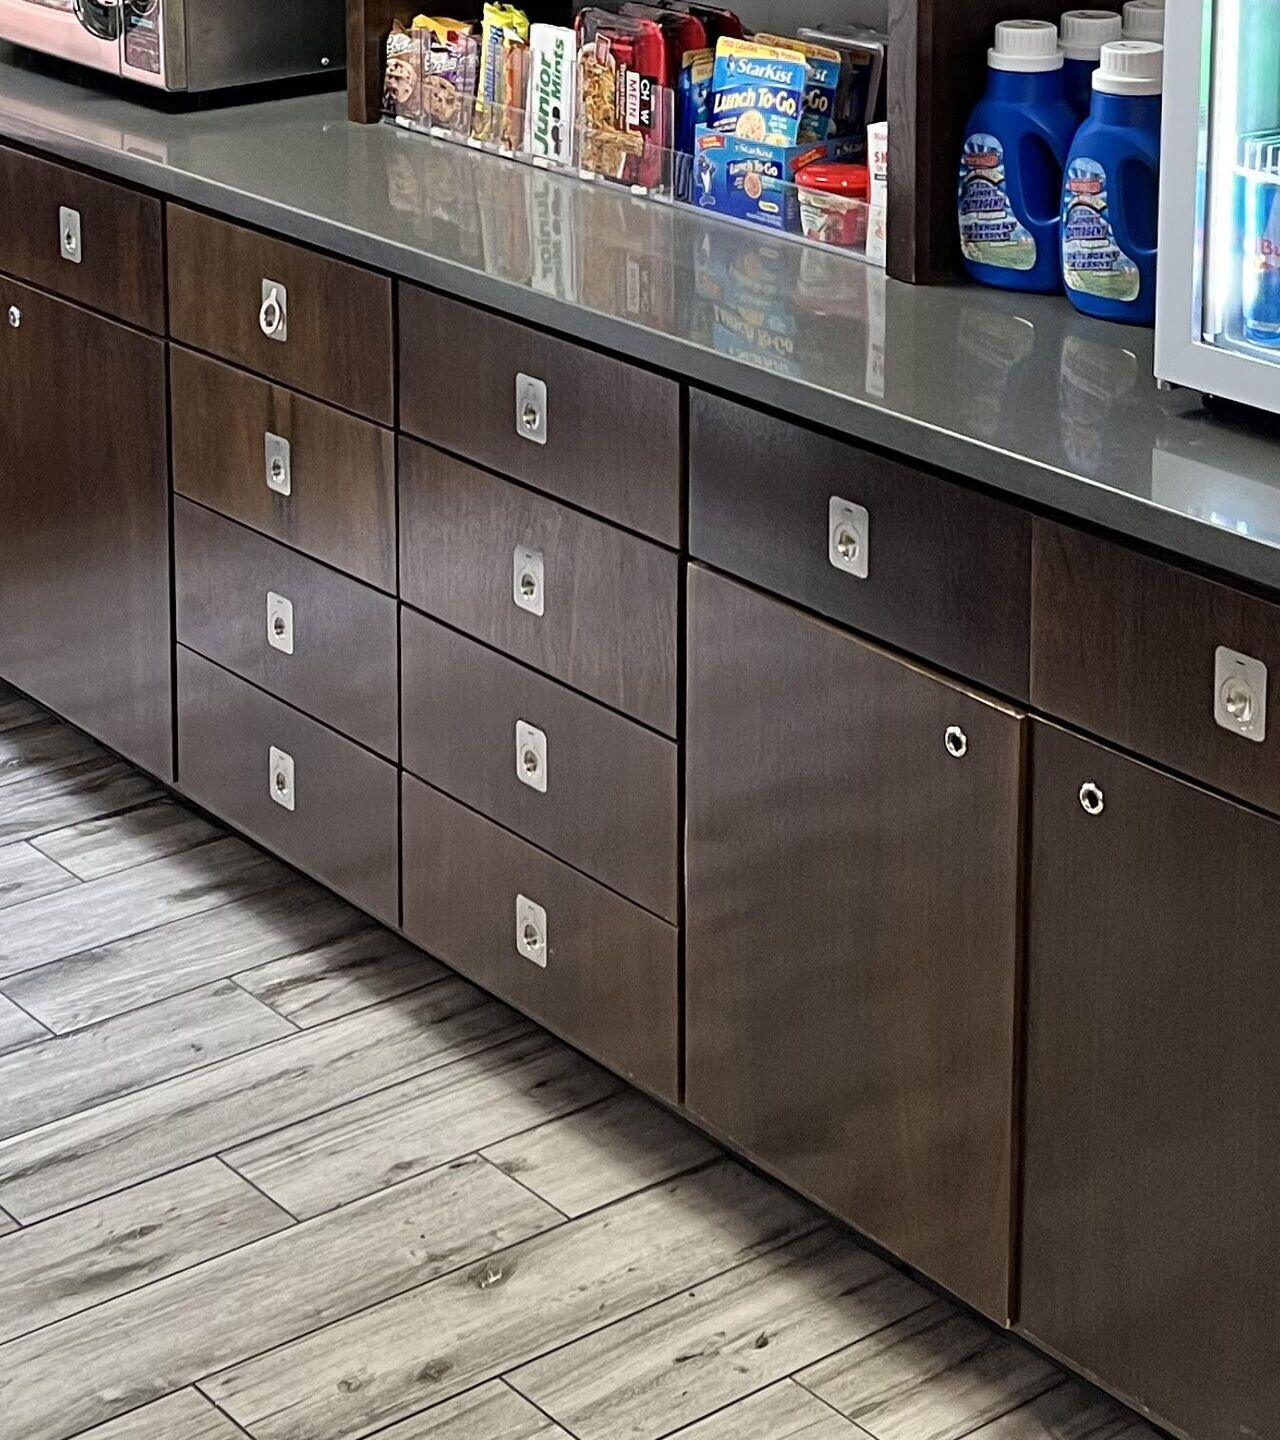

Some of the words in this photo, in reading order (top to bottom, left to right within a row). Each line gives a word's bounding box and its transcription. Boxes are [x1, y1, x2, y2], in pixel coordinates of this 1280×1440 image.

[550, 37, 565, 102] Mints
[737, 58, 794, 84] StarKist
[533, 51, 552, 156] Junior
[628, 79, 637, 118] MEIN
[713, 87, 757, 114] Lunch
